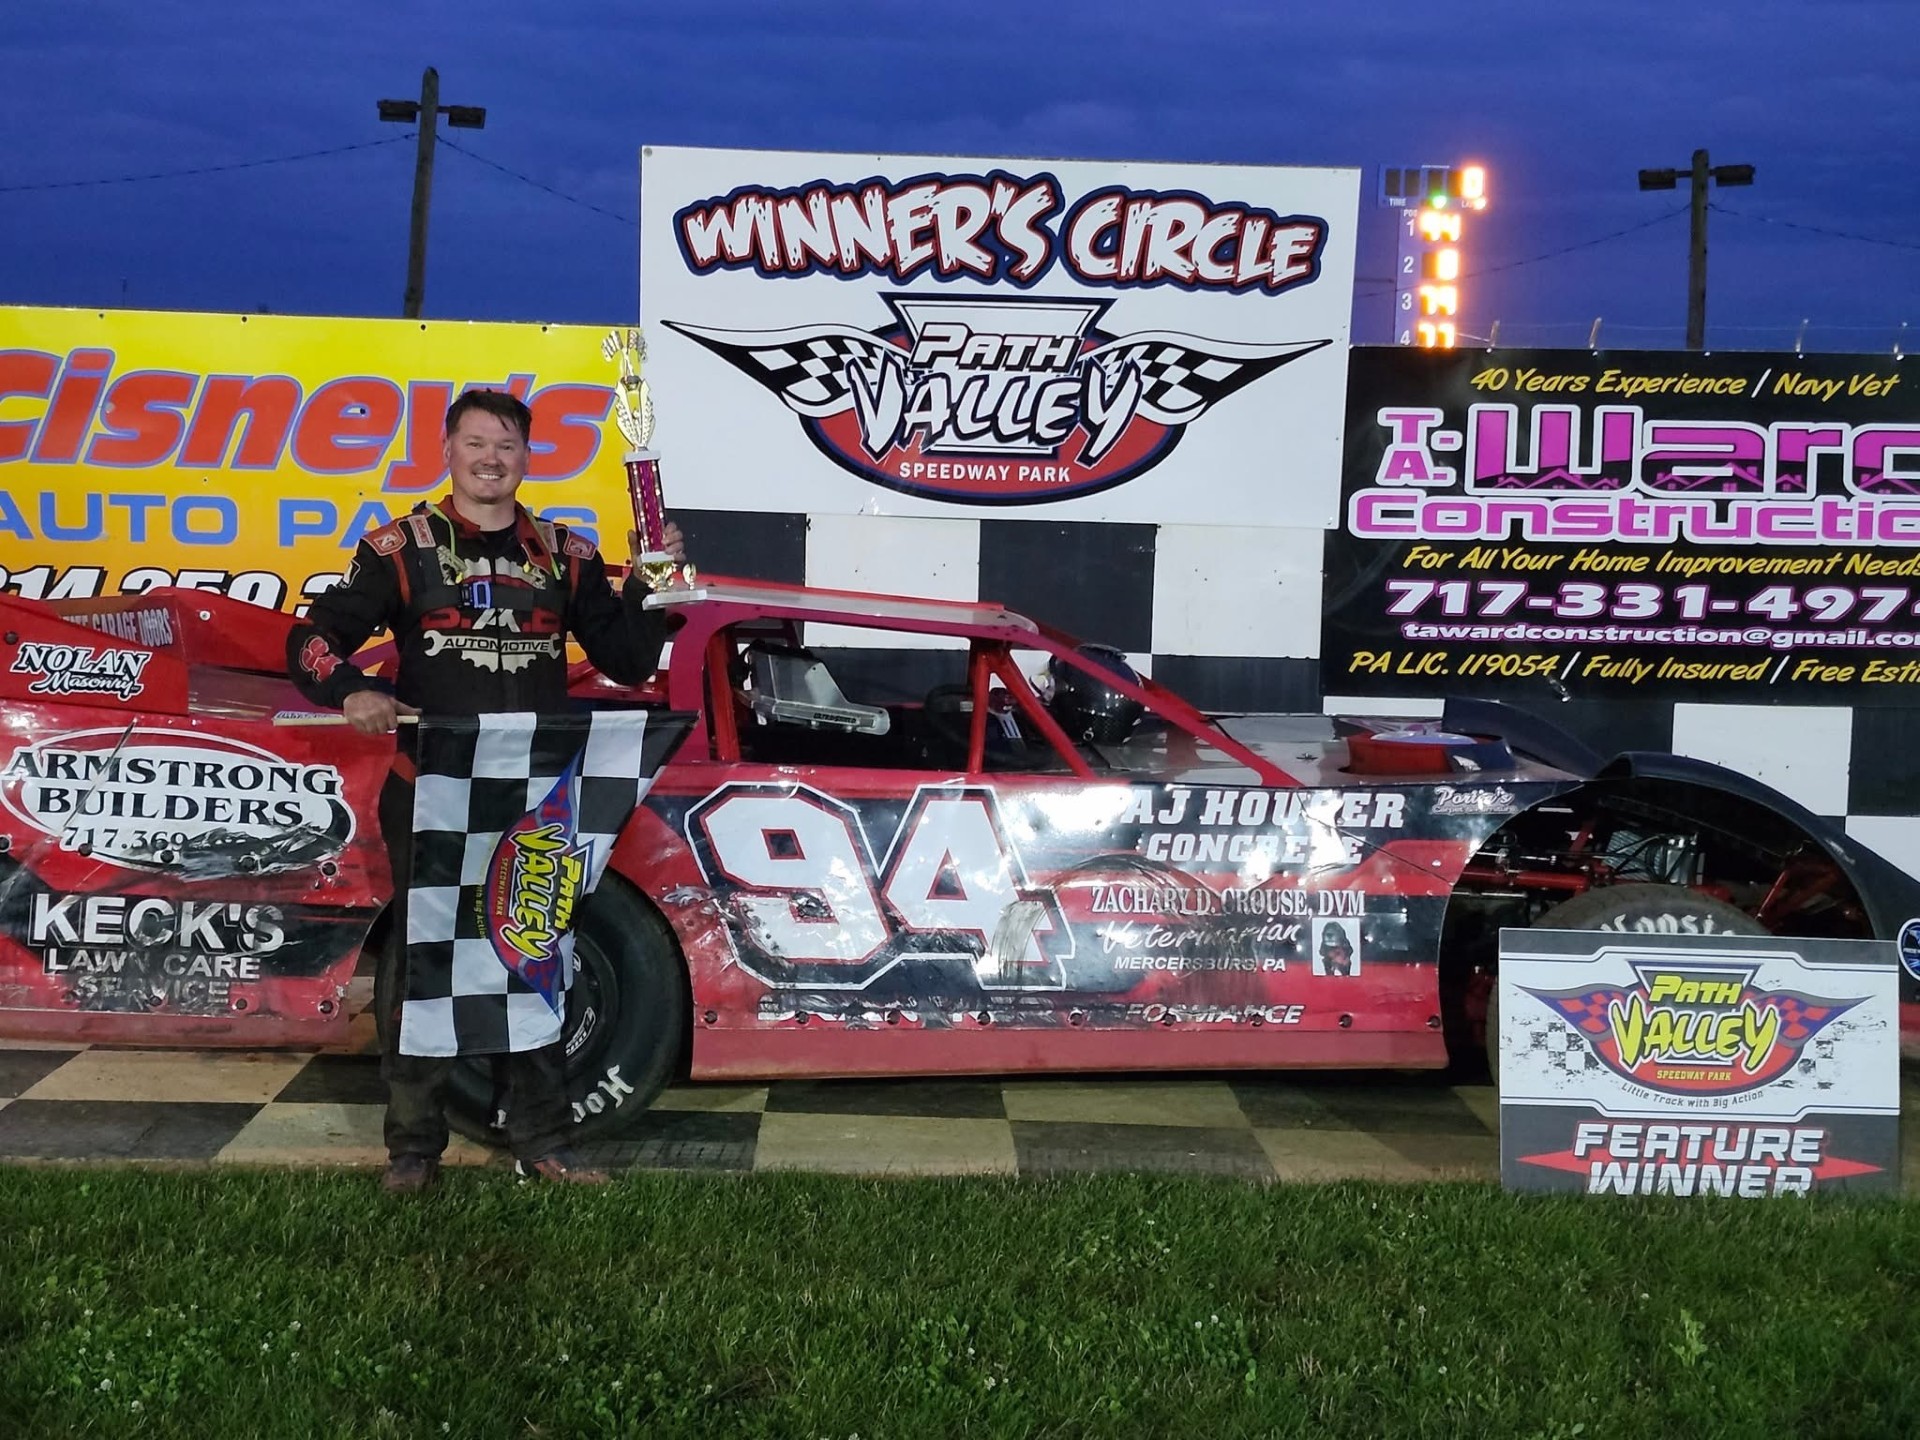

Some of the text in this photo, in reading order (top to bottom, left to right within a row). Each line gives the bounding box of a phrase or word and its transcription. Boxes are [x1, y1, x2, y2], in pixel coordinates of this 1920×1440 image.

[685, 178, 1318, 286] WINNER'S CIRCLE
[909, 321, 1082, 373] PATH
[1470, 367, 1508, 391] 40
[1514, 369, 1588, 393] Years
[1594, 369, 1747, 398] Experience
[1773, 372, 1844, 402] Navy
[1848, 375, 1899, 397] Vet
[846, 354, 1143, 464] VALLEY
[899, 461, 1071, 483] SPEEDWAY PARK
[0, 490, 239, 545] AUTO
[278, 498, 600, 550] PAS
[1402, 545, 1454, 569] For
[1457, 546, 1500, 570] All
[1500, 548, 1563, 572] Your
[1568, 548, 1650, 573] Home
[1654, 550, 1843, 578] Improvement
[1386, 580, 1920, 622] 717-331-497
[137, 607, 174, 648] DOORS
[442, 637, 550, 652] AUTOMOTIVE
[13, 643, 149, 677] NOLAN
[1349, 651, 1392, 674] PA
[1396, 652, 1449, 675] LIC.
[1457, 654, 1561, 677] 119054
[1581, 655, 1653, 684] Fully
[1656, 656, 1772, 681] Insured
[1790, 659, 1858, 683] Free
[31, 670, 134, 697] Masonry
[5, 751, 338, 796] ARMSTRONG
[37, 787, 304, 828] BUILDERS
[1120, 789, 1191, 825] AJ
[1146, 832, 1367, 865] CONCREE
[501, 825, 568, 959] VALLEY
[554, 855, 582, 930] PATH
[693, 788, 1066, 978] 94
[1091, 886, 1190, 914] ZACHARY
[1221, 888, 1314, 919] CROUSE,
[1317, 890, 1367, 917] DVM
[33, 892, 285, 952] KECK'S
[163, 953, 261, 979] CARE
[1262, 957, 1287, 972] PA
[1648, 975, 1744, 1005] PATH
[1611, 995, 1779, 1071] VALLEY
[1656, 1070, 1732, 1081] SPEEDWAY PARK
[1621, 1082, 1764, 1109] Little Track with Big Action
[1573, 1123, 1824, 1163] FEATURE
[1587, 1162, 1813, 1200] WINNER
